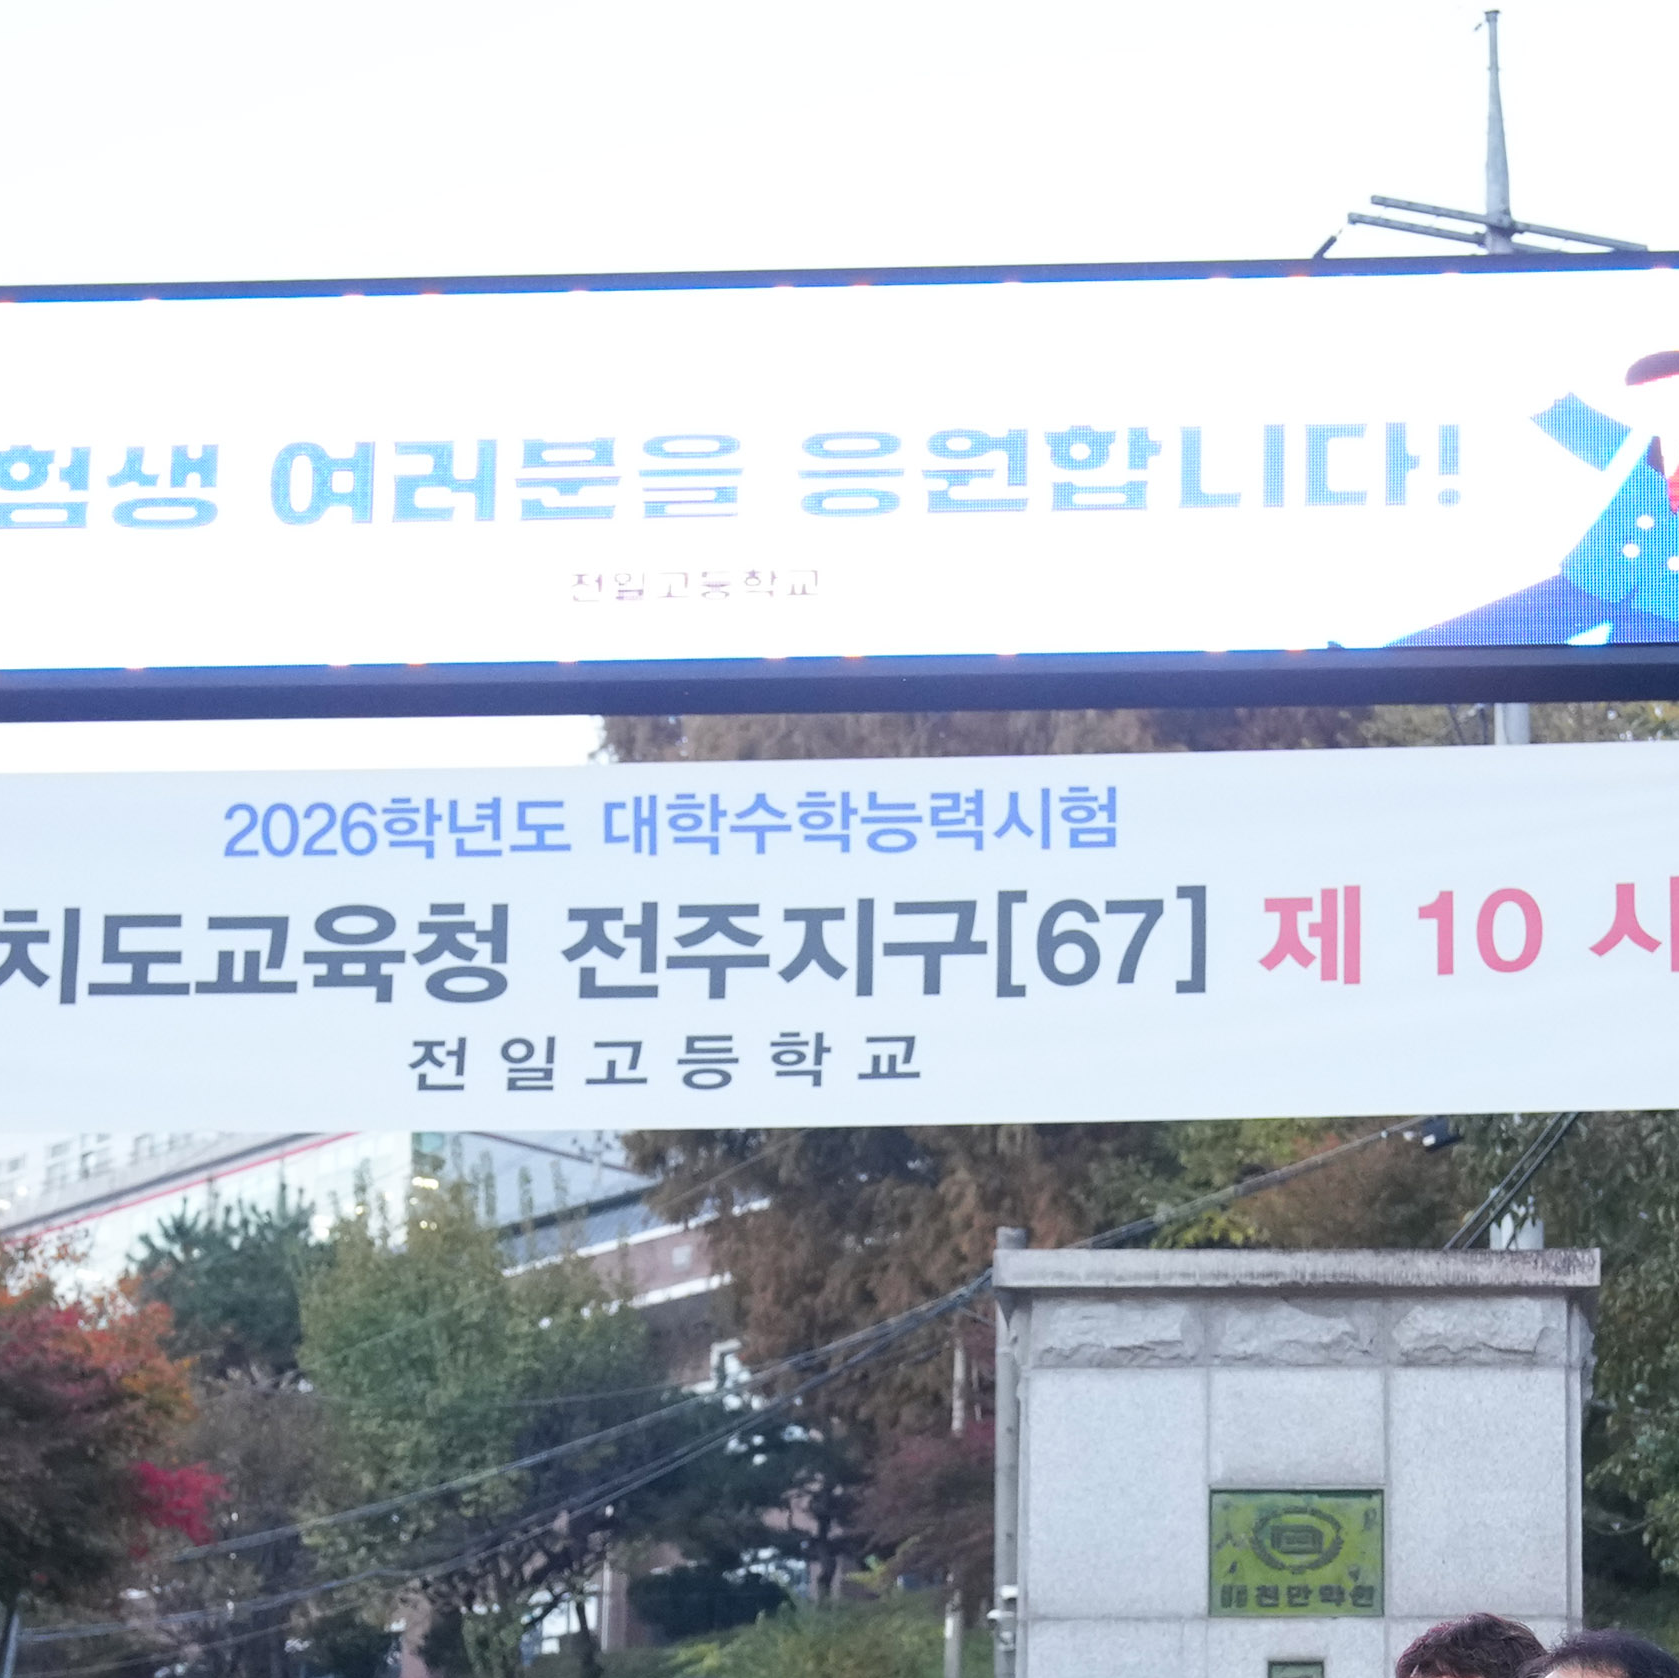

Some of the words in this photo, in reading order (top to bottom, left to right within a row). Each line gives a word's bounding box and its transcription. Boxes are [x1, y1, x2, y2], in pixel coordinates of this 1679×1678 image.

[270, 434, 744, 525] 여러분을
[798, 422, 1461, 517] 응원합니다!
[222, 795, 572, 860] 2026학년도
[603, 786, 1119, 857] 대학수학능력시험
[561, 885, 1207, 999] 전주지구[67]
[1258, 885, 1362, 985] 제
[1417, 888, 1544, 976] 10
[407, 1031, 922, 1092] 전일고등학교
